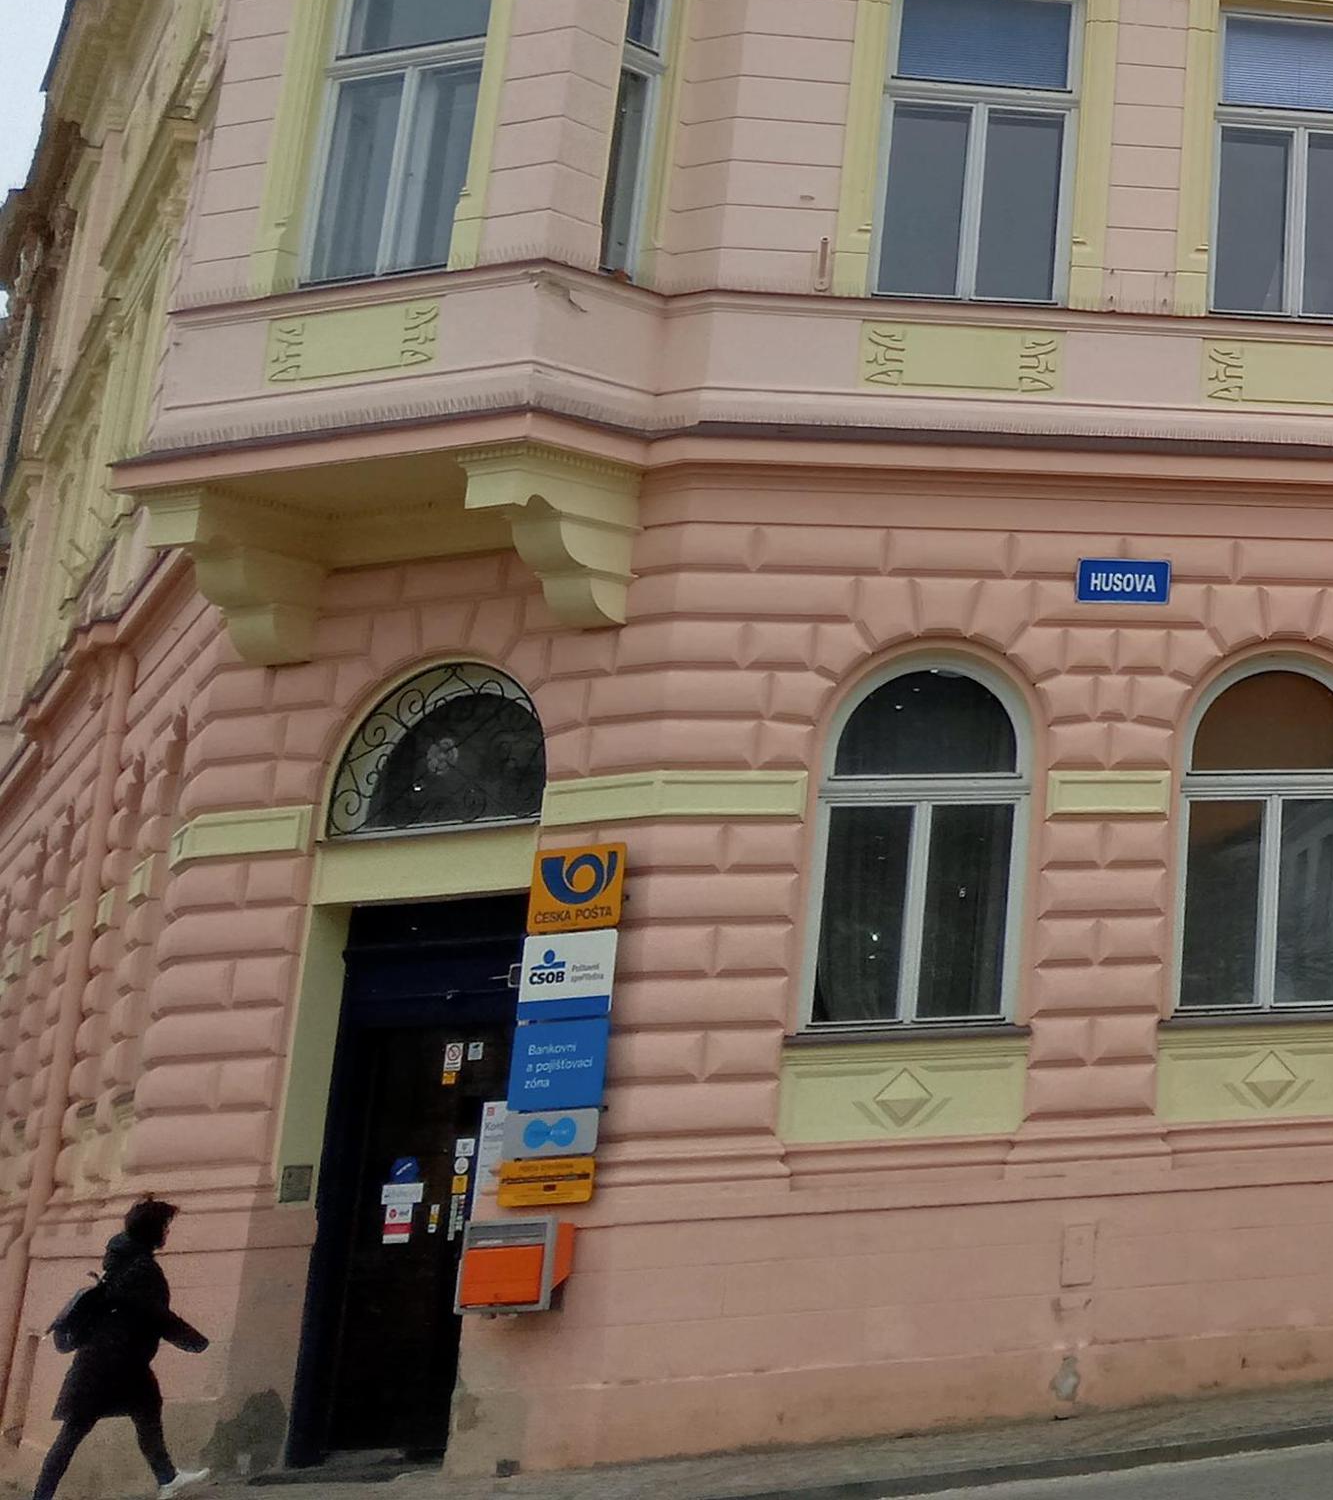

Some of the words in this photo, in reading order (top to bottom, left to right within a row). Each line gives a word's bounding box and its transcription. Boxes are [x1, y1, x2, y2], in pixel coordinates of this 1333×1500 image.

[1090, 572, 1157, 593] HUSOVA
[575, 905, 612, 920] POŠTA
[526, 1063, 533, 1073] a
